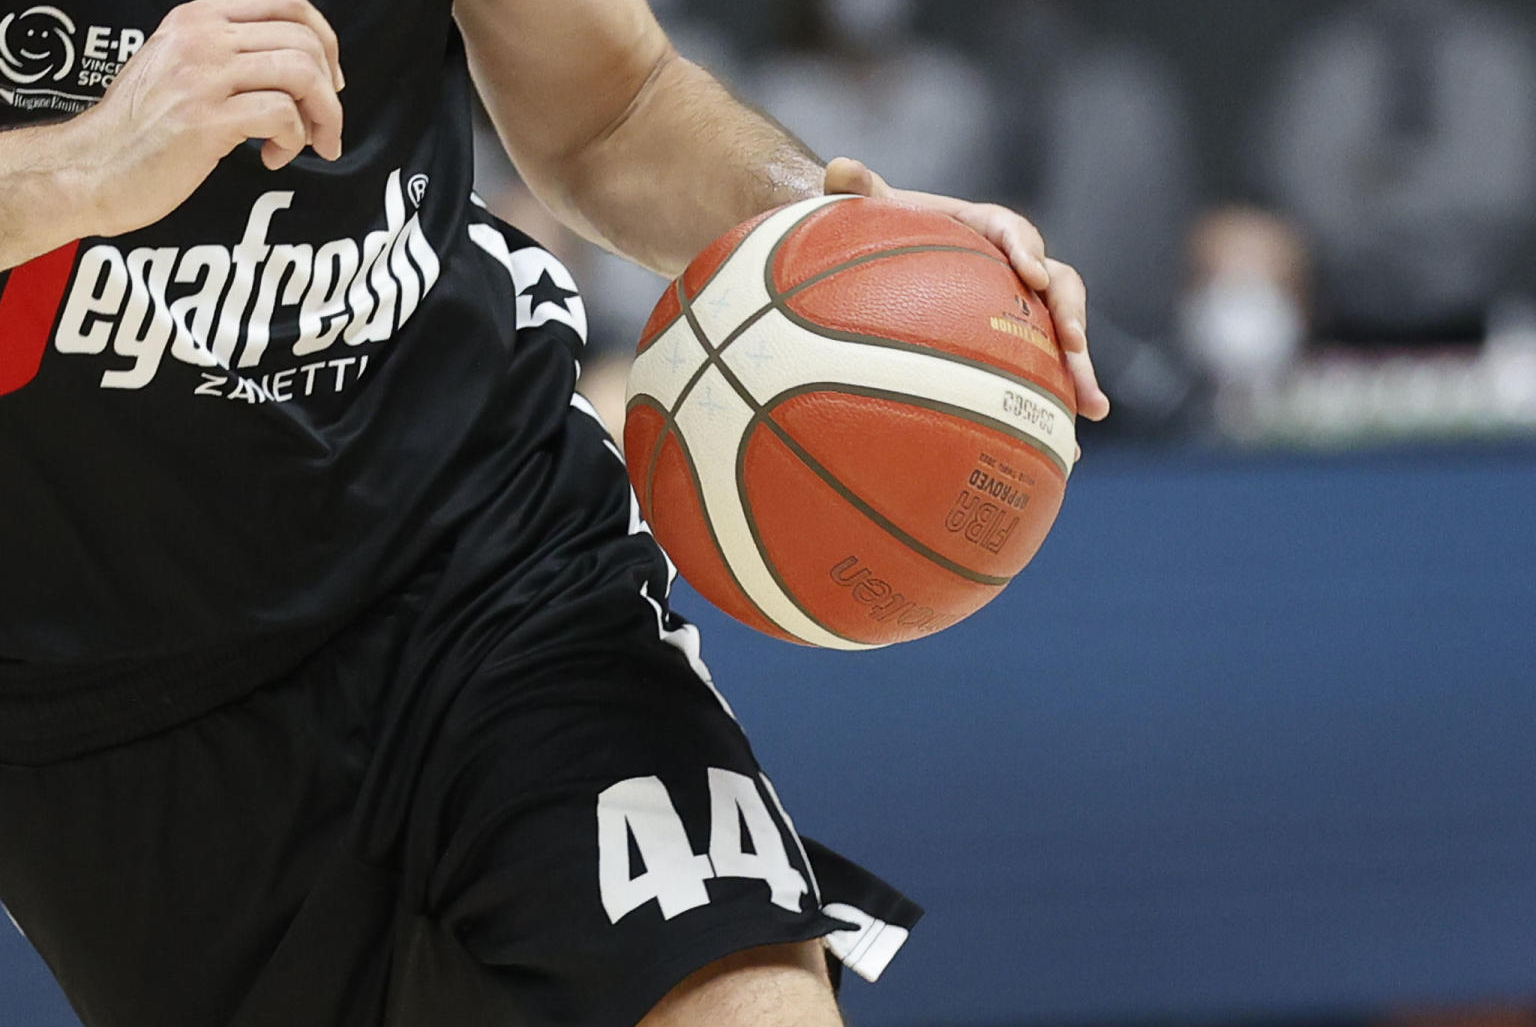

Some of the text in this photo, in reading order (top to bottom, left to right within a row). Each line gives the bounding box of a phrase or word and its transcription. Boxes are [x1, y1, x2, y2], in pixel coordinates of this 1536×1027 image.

[945, 489, 1021, 554] FIBA
[969, 468, 1031, 510] APPROVED
[597, 767, 809, 925] 44
